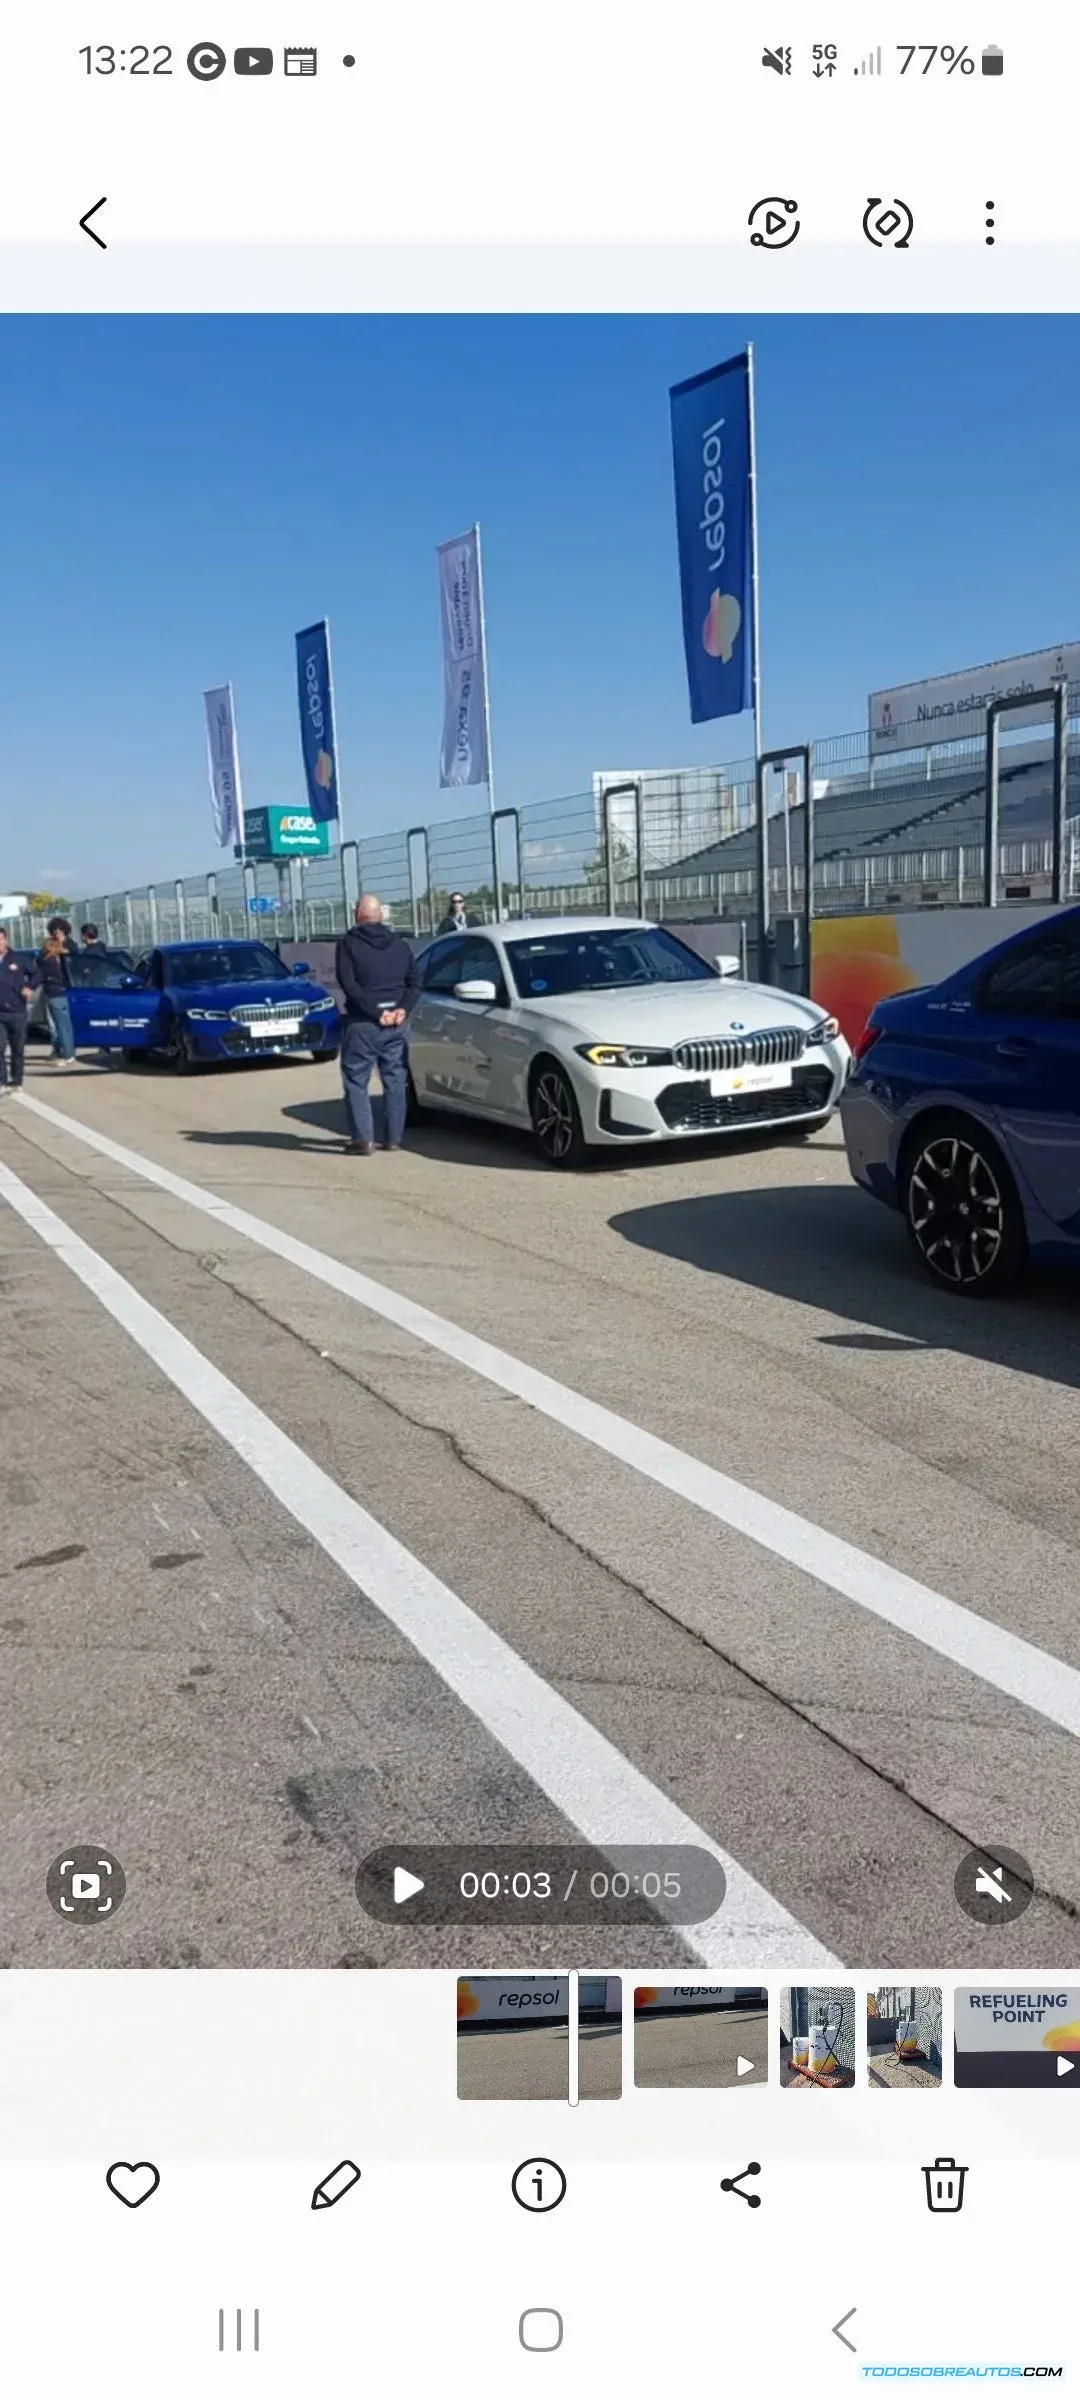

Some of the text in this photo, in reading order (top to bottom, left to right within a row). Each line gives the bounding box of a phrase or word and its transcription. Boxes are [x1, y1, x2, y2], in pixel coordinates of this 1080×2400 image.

[79, 45, 173, 75] 13:22
[812, 44, 838, 60] 5G
[896, 45, 975, 75] 77%
[917, 704, 954, 721] Nunca
[1006, 680, 1035, 699] solo
[460, 1870, 681, 1901] 00:03 / 00:05
[498, 1989, 560, 2008] repsol
[969, 1993, 1068, 2009] REFUELING
[992, 2010, 1046, 2023] POINT
